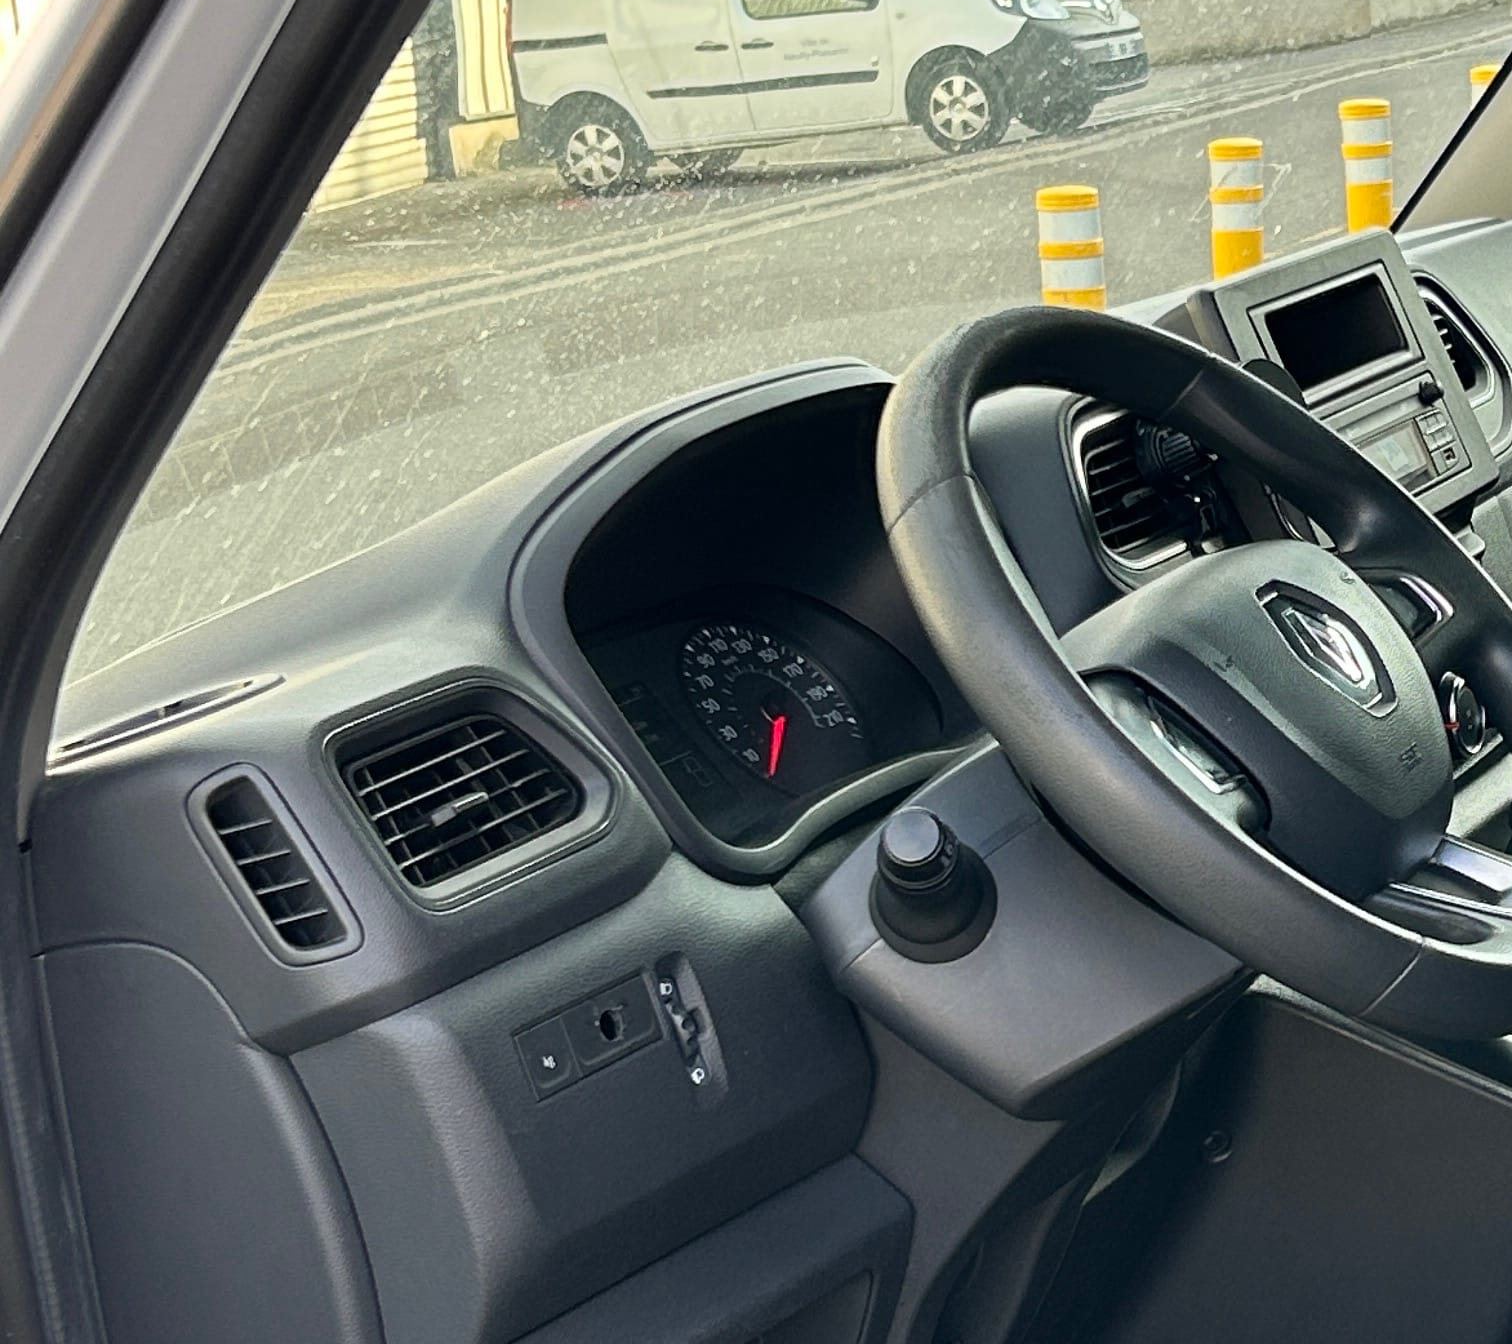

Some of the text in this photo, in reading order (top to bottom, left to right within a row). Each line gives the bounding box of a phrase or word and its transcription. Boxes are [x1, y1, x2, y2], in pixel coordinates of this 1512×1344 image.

[783, 662, 803, 678] 170
[695, 674, 714, 690] 70
[701, 698, 721, 714] 50
